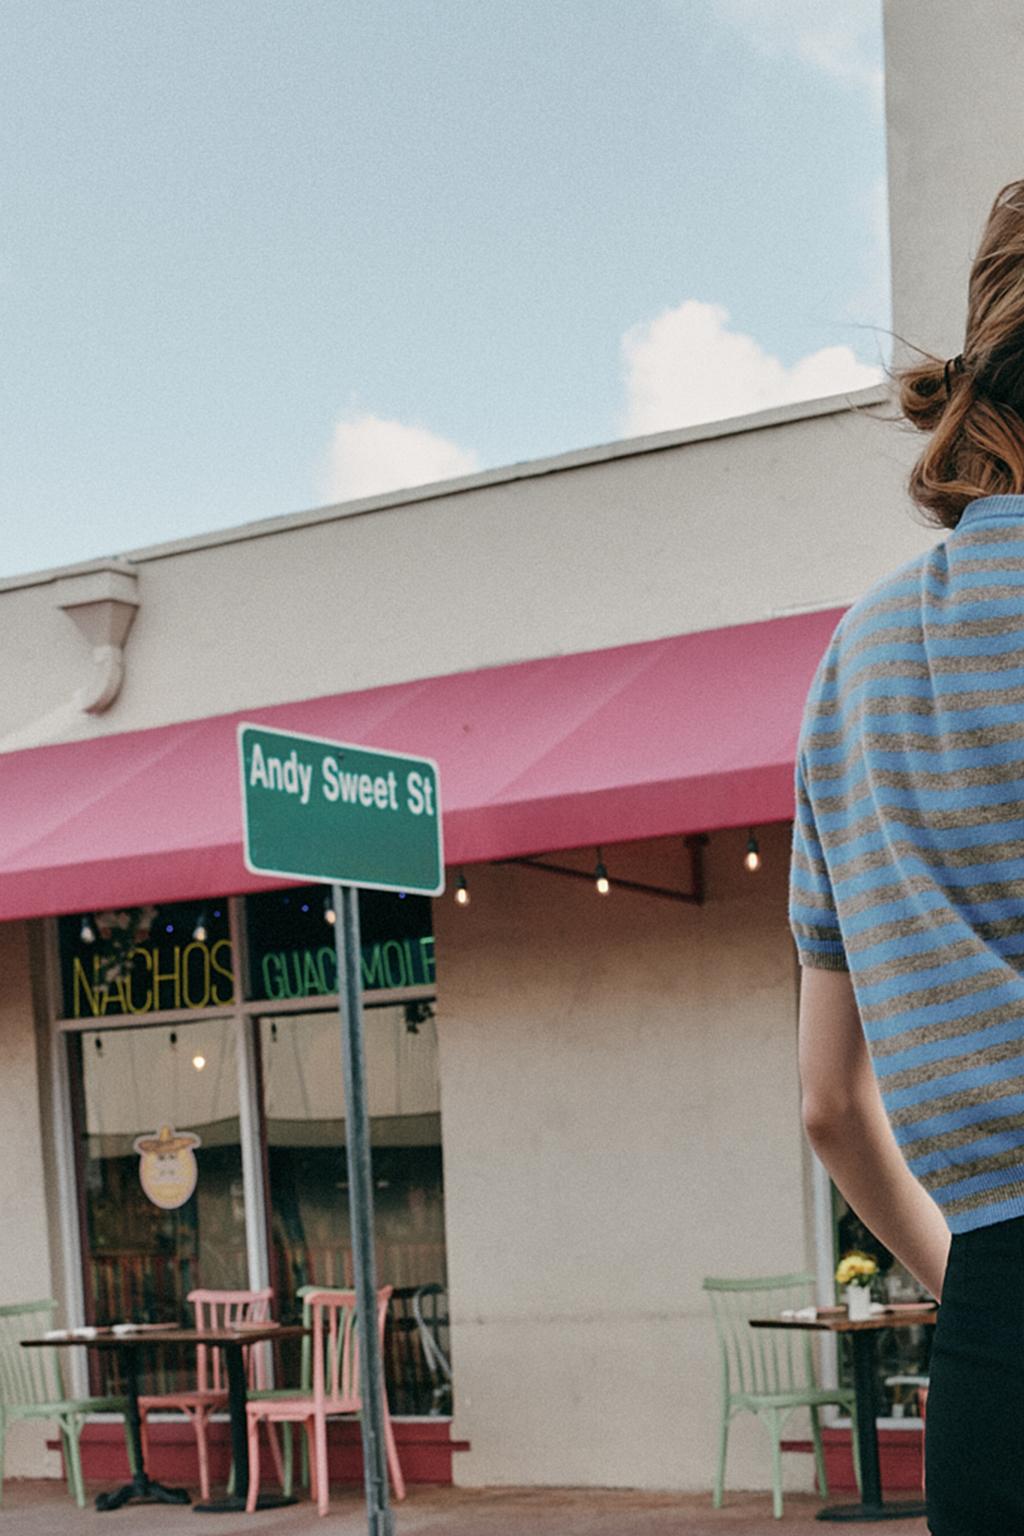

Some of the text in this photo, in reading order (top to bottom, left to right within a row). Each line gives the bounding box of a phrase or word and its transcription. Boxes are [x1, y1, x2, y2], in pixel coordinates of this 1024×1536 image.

[250, 743, 434, 816] Andy Sweet St
[73, 939, 235, 1018] NACHOS
